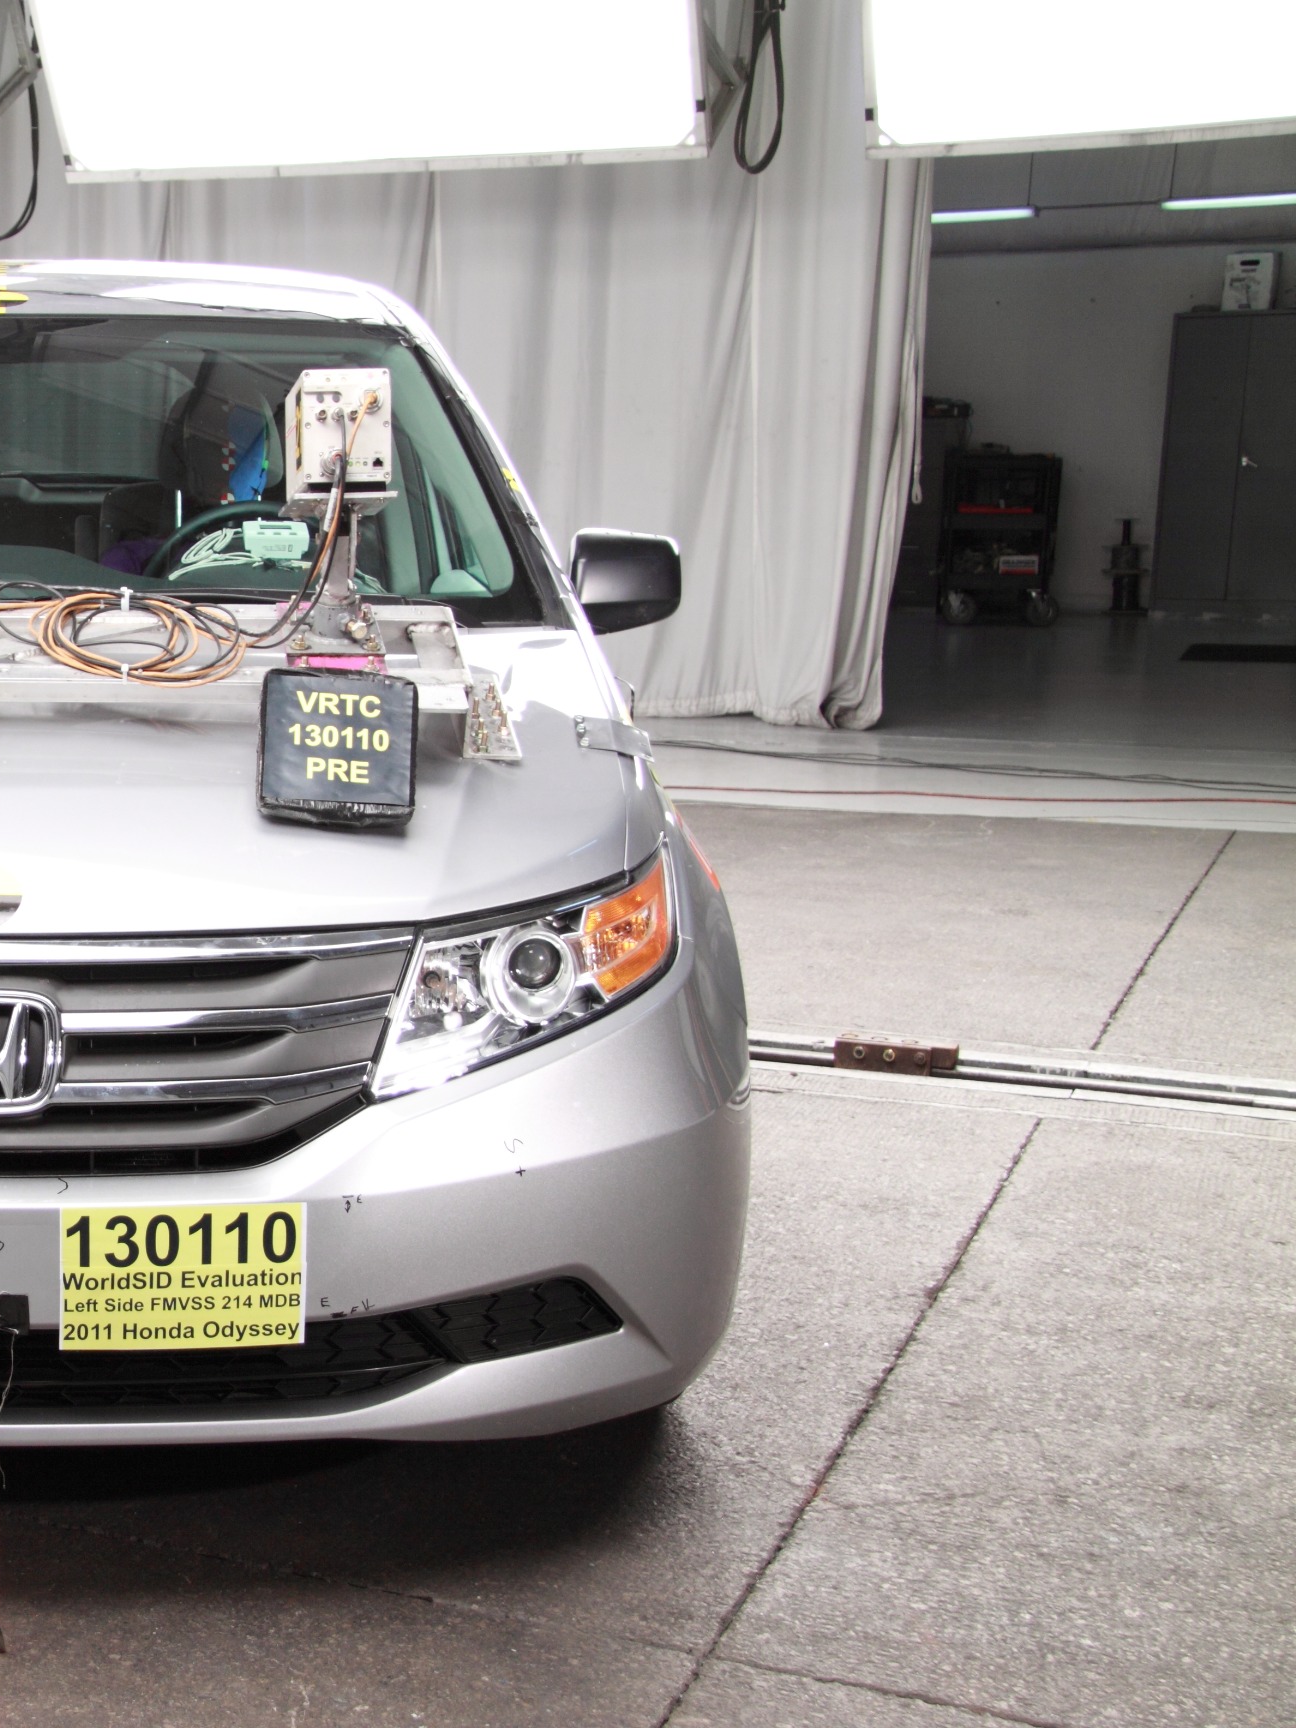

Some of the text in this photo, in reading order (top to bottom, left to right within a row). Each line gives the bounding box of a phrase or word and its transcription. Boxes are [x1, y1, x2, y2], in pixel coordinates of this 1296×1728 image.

[296, 690, 381, 718] VRTC
[288, 723, 389, 752] 130110
[306, 756, 369, 784] PRE
[66, 1211, 297, 1268] 130110
[62, 1268, 302, 1291] WorldSID Evaluation
[64, 1293, 301, 1313] Left Side FMVSS 214 MDB
[63, 1320, 300, 1342] 2011 Honda Odyssey
